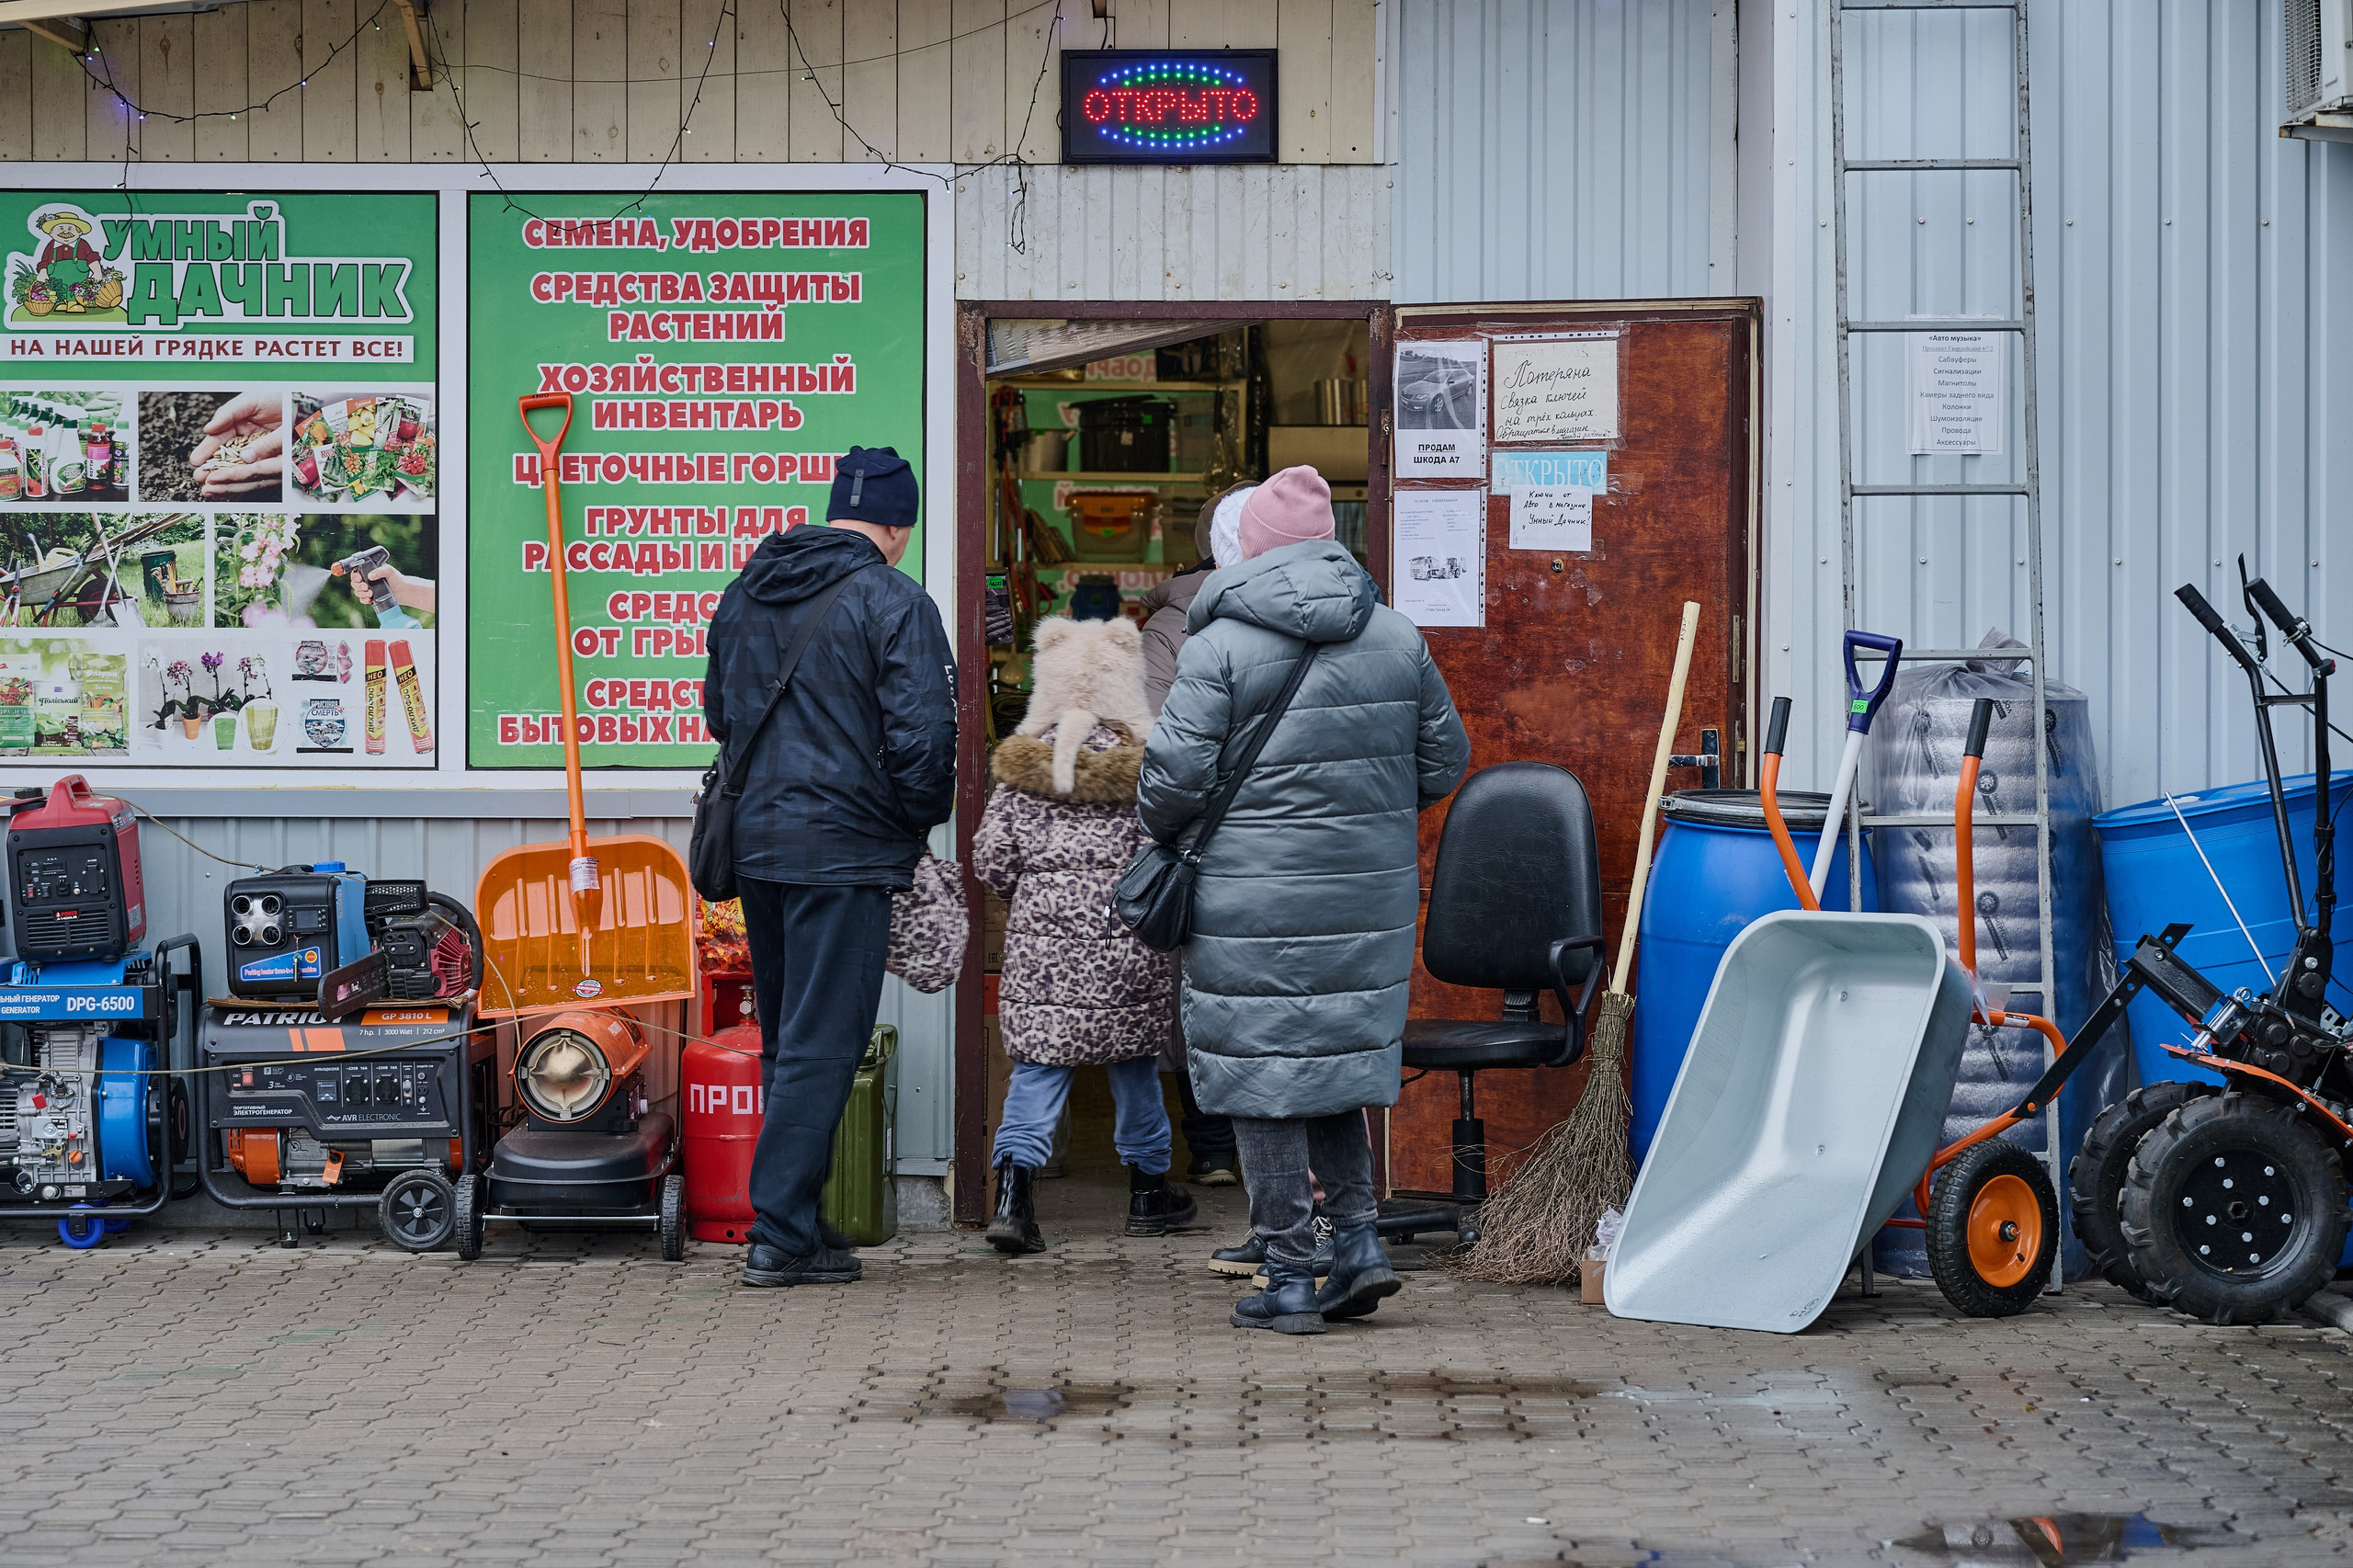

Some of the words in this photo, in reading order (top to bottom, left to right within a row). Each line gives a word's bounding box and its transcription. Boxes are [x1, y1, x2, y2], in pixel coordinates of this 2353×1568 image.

[1085, 90, 1256, 120] ОТКРЫТО
[102, 206, 279, 261] УМНЫЙ
[523, 219, 667, 249] СЕМЕНА,
[675, 219, 868, 251] УДОБРЕНИЯ
[127, 263, 408, 324] ДАЧНИК
[531, 274, 705, 305] СРЕДСТВА
[709, 274, 860, 305] ЗАЩИТЫ
[609, 304, 783, 340] РАСТЕНИЙ
[10, 339, 44, 357] НА
[55, 335, 144, 357] НАШЕЙ
[154, 339, 244, 359] ГРЯДКЕ
[255, 339, 341, 358] РАСТЕТ
[351, 340, 403, 358] ВСЕ!
[1938, 356, 1977, 364] Сабвуферы
[540, 356, 855, 392] ХОЗЯЙСТВЕННЫЙ
[1504, 360, 1591, 390] Потеряна
[1933, 368, 1982, 376] Сигнализации
[1500, 392, 1538, 415] Связка
[1545, 387, 1586, 403] ключей
[595, 402, 802, 429] ИНВЕНТАРЬ
[1505, 416, 1520, 426] на
[515, 454, 726, 486] ЦЕТОЧНЫЕ
[734, 454, 838, 482] ГОРШ
[1414, 456, 1447, 465] ШКОДА
[1449, 456, 1461, 464] А7
[1523, 500, 1539, 508] Авто
[1555, 502, 1586, 510] магазине
[1529, 490, 1553, 498] Ключи
[586, 507, 726, 535] ГРУНТЫ
[733, 507, 807, 538] ДЛЯ
[699, 543, 725, 570] И
[608, 593, 723, 623] СРЕДС
[574, 628, 620, 656] ОТ
[634, 628, 710, 656] ГРЫ
[39, 696, 79, 706] Поліський
[244, 969, 261, 977] Parking
[21, 994, 61, 1003] ГЕНЕРАТОР
[66, 995, 135, 1012] DPG-6500
[381, 1012, 397, 1020] GP
[399, 1012, 424, 1020] 3810
[690, 1083, 764, 1115] ПРО
